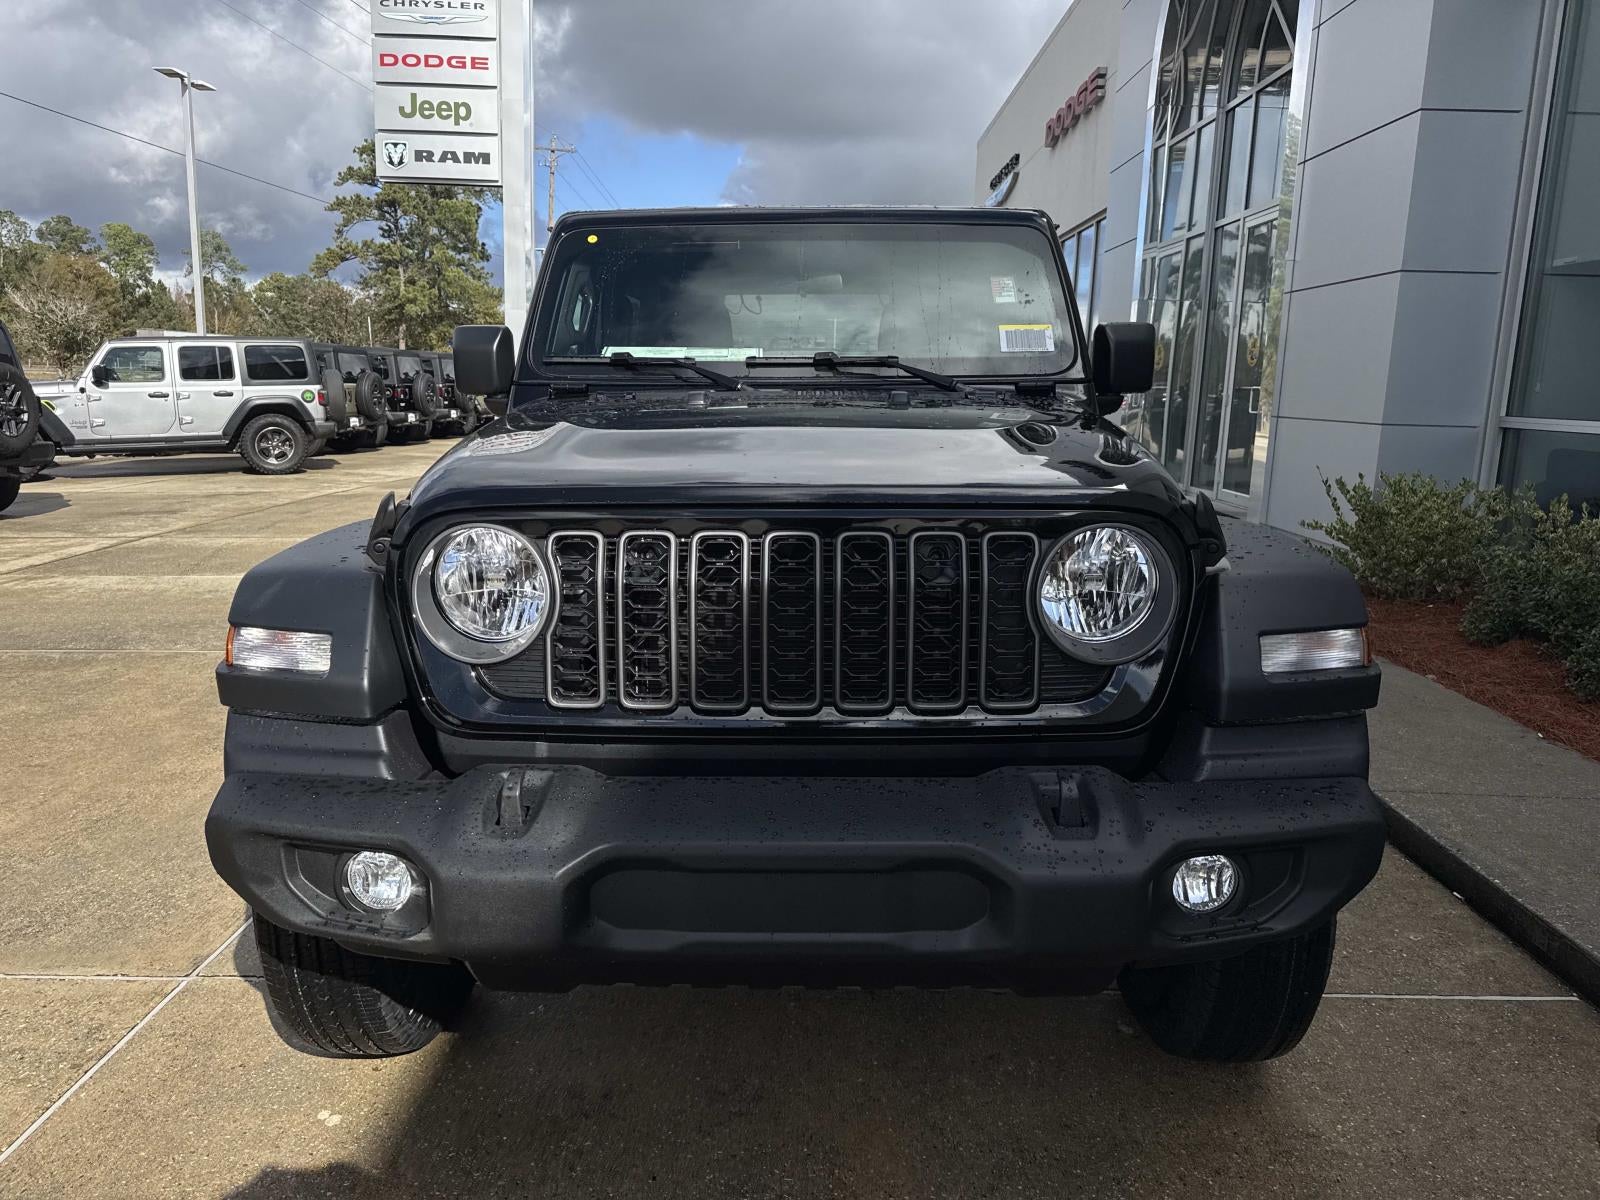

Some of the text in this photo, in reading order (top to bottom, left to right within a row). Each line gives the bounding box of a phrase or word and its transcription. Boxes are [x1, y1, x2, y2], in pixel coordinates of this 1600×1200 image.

[380, 0, 485, 10] CHRYSLER
[379, 53, 489, 70] DODGE
[399, 93, 472, 126] Jeep
[1045, 67, 1107, 147] DODGE
[414, 149, 491, 165] RAM
